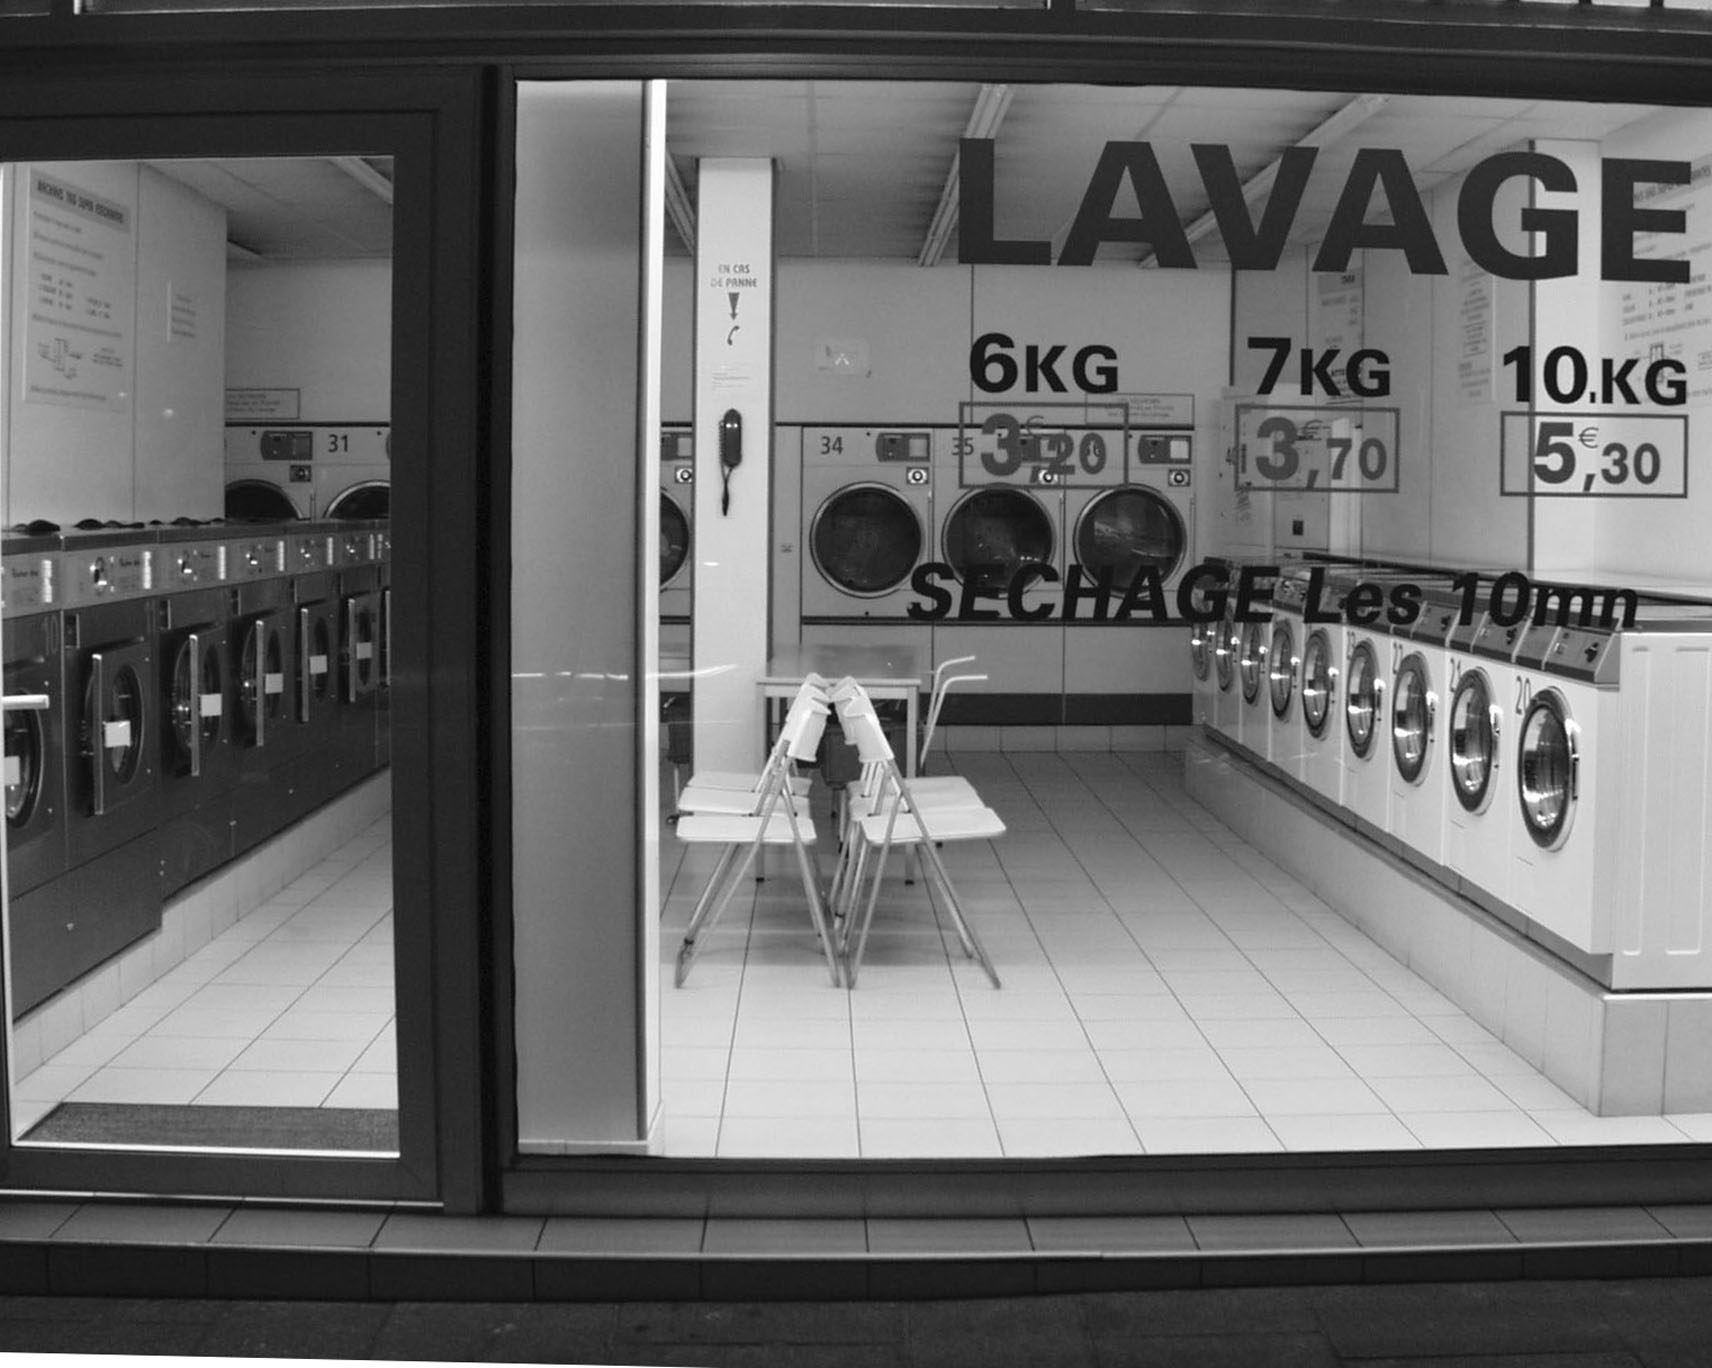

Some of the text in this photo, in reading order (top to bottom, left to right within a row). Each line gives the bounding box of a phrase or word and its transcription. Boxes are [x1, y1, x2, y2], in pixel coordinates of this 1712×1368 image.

[958, 137, 1692, 283] LAVAGE
[726, 278, 757, 288] PANNE
[328, 433, 349, 453] 31
[820, 436, 843, 455] 34
[952, 437, 974, 456] 35
[907, 561, 1639, 629] SECHAGE Les 10mn
